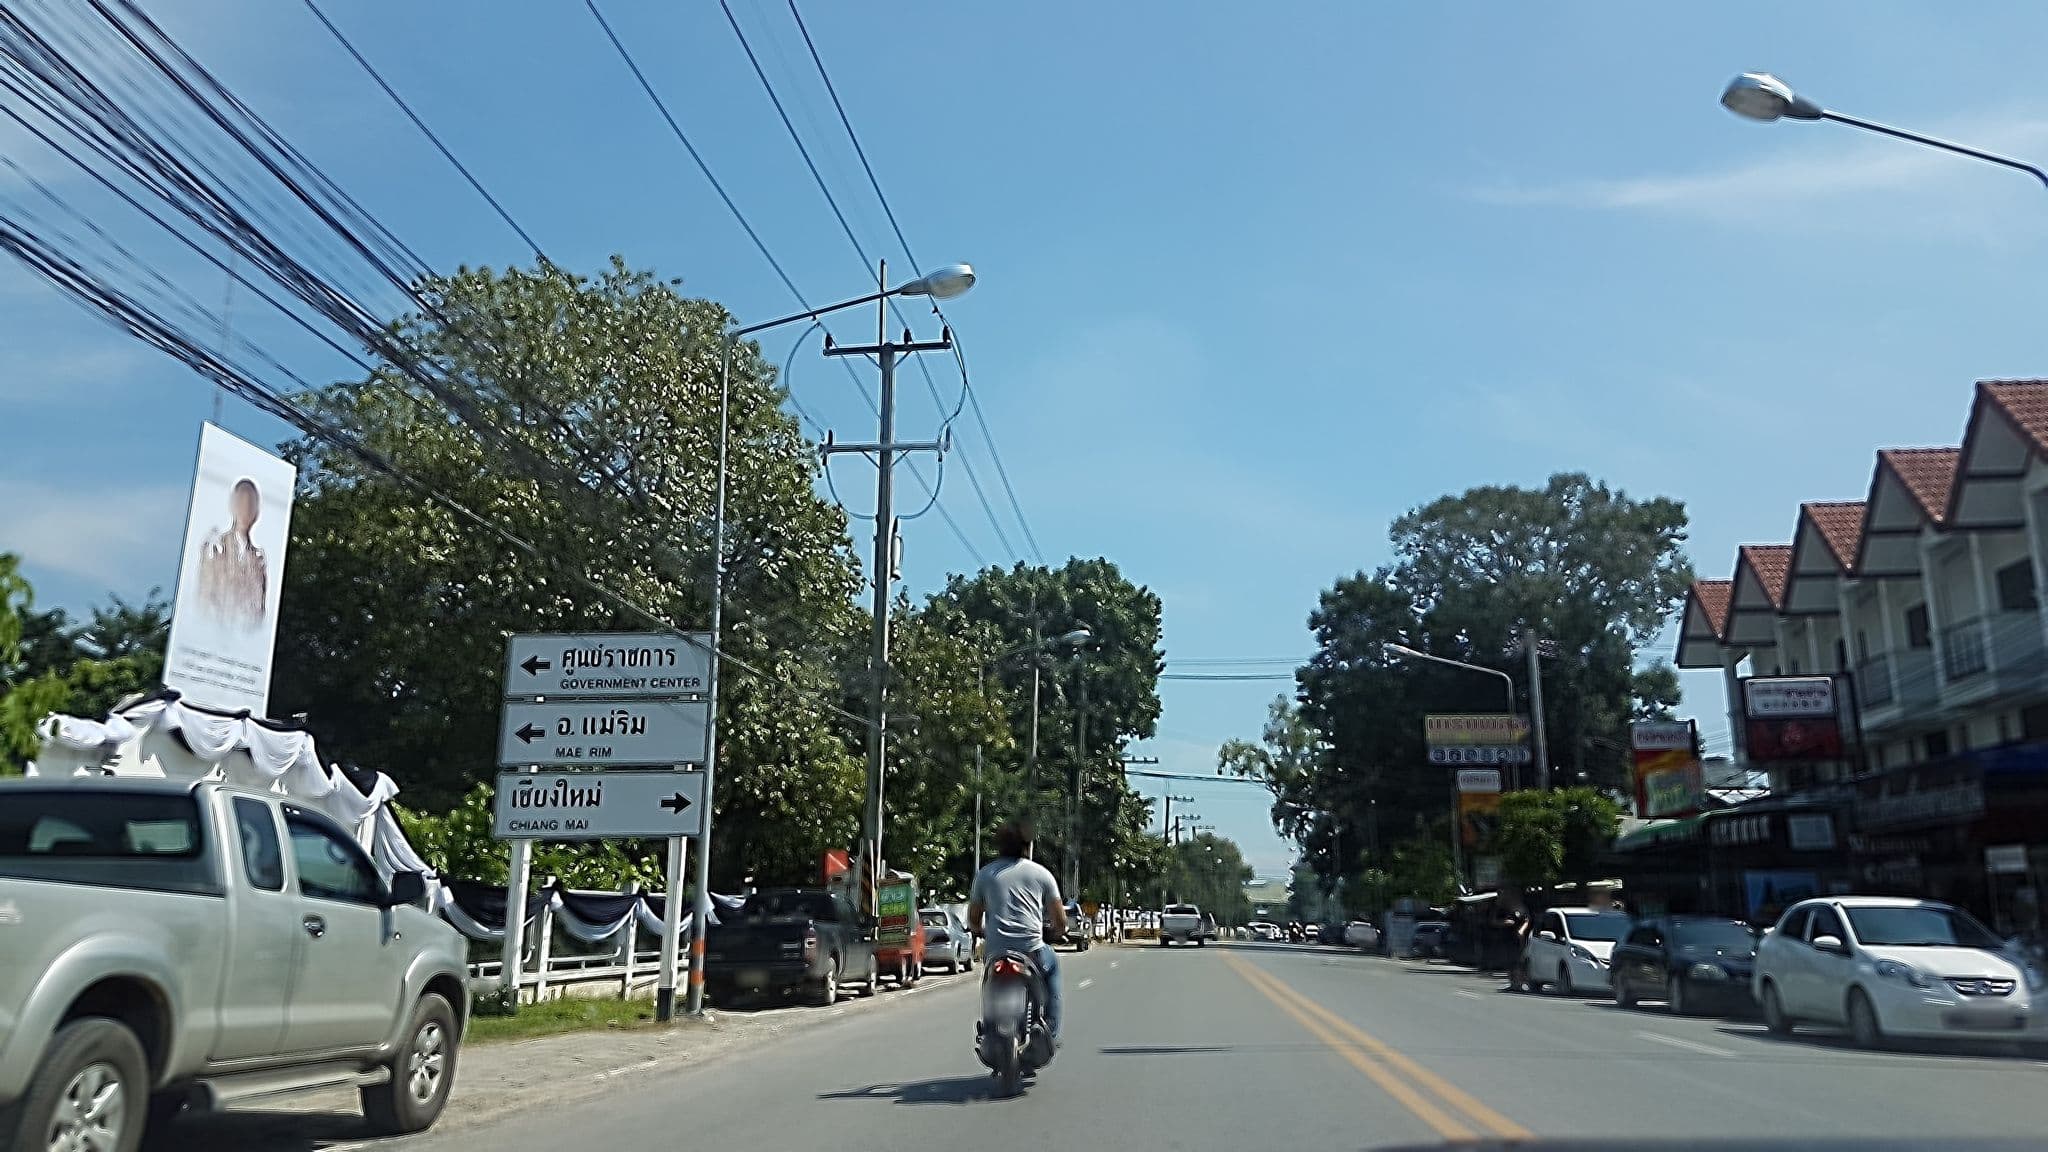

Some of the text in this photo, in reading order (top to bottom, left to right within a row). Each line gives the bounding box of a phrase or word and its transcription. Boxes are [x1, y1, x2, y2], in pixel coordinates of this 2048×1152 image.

[560, 676, 701, 690] GOVERNMENT CENTER
[557, 709, 646, 736] อ. แม่ริม
[554, 746, 613, 758] MAE RIM
[511, 778, 602, 809] เชียงใหม่
[508, 819, 589, 832] CHIANG MAI
